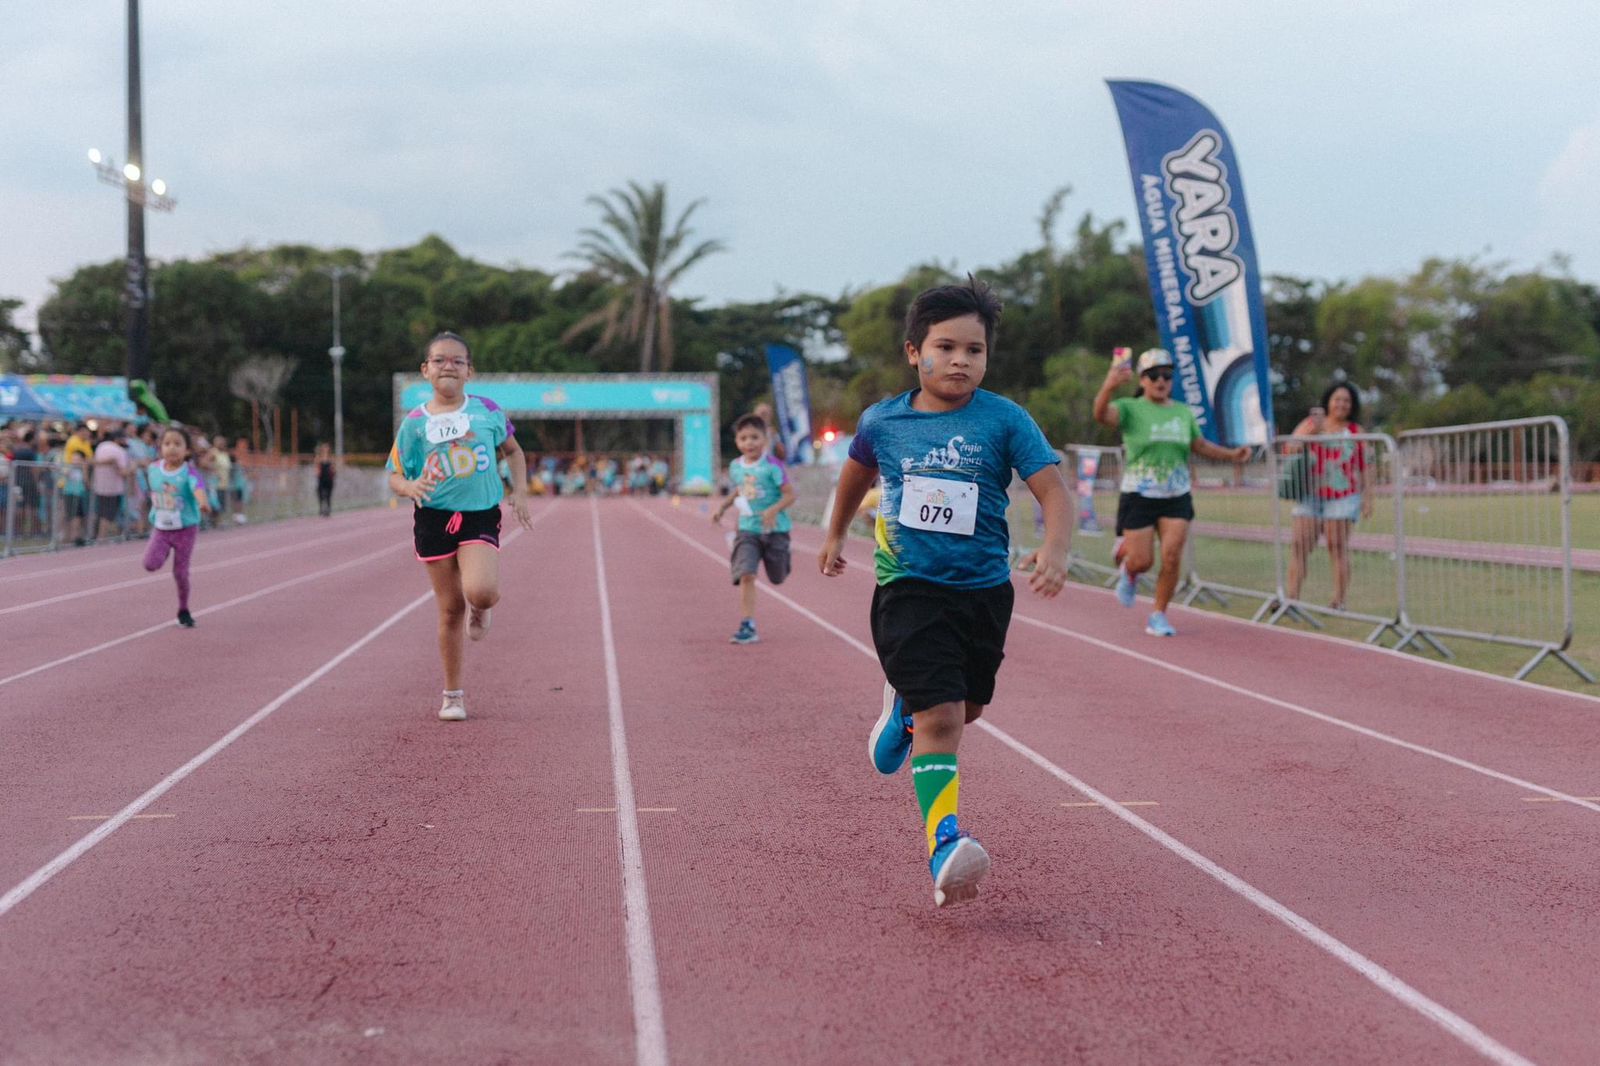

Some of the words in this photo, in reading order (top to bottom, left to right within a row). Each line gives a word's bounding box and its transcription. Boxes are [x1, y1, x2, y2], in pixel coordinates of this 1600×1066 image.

[1163, 131, 1243, 304] YARA
[1153, 236, 1186, 333] MINERAL
[439, 426, 458, 438] 176
[427, 443, 490, 482] KIDS
[920, 504, 954, 525] 079
